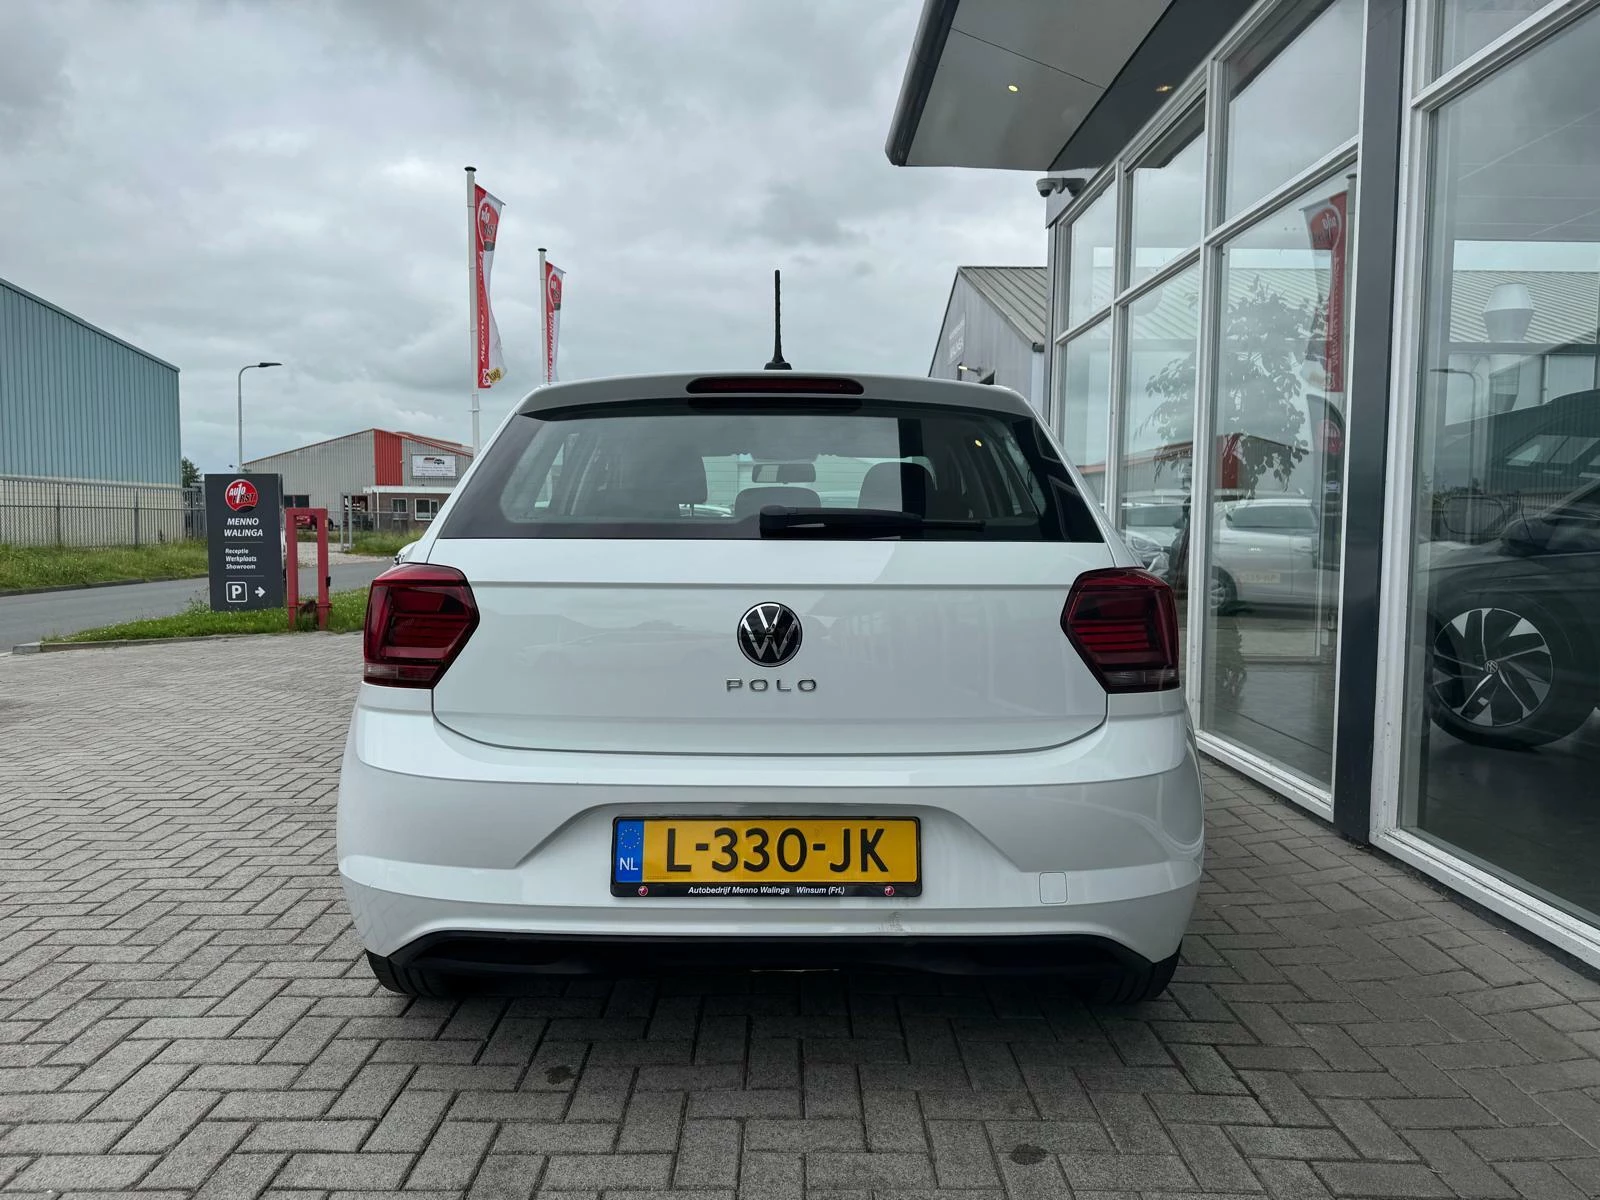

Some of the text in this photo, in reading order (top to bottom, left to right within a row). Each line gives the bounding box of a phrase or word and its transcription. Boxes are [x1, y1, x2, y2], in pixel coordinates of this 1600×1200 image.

[227, 517, 259, 526] MENNO
[224, 529, 264, 537] WALINGA
[726, 679, 817, 692] POLO
[665, 827, 889, 873] L-330-JK
[619, 857, 639, 871] NL
[688, 886, 730, 895] Autobedrijf
[760, 887, 790, 896] Walinga
